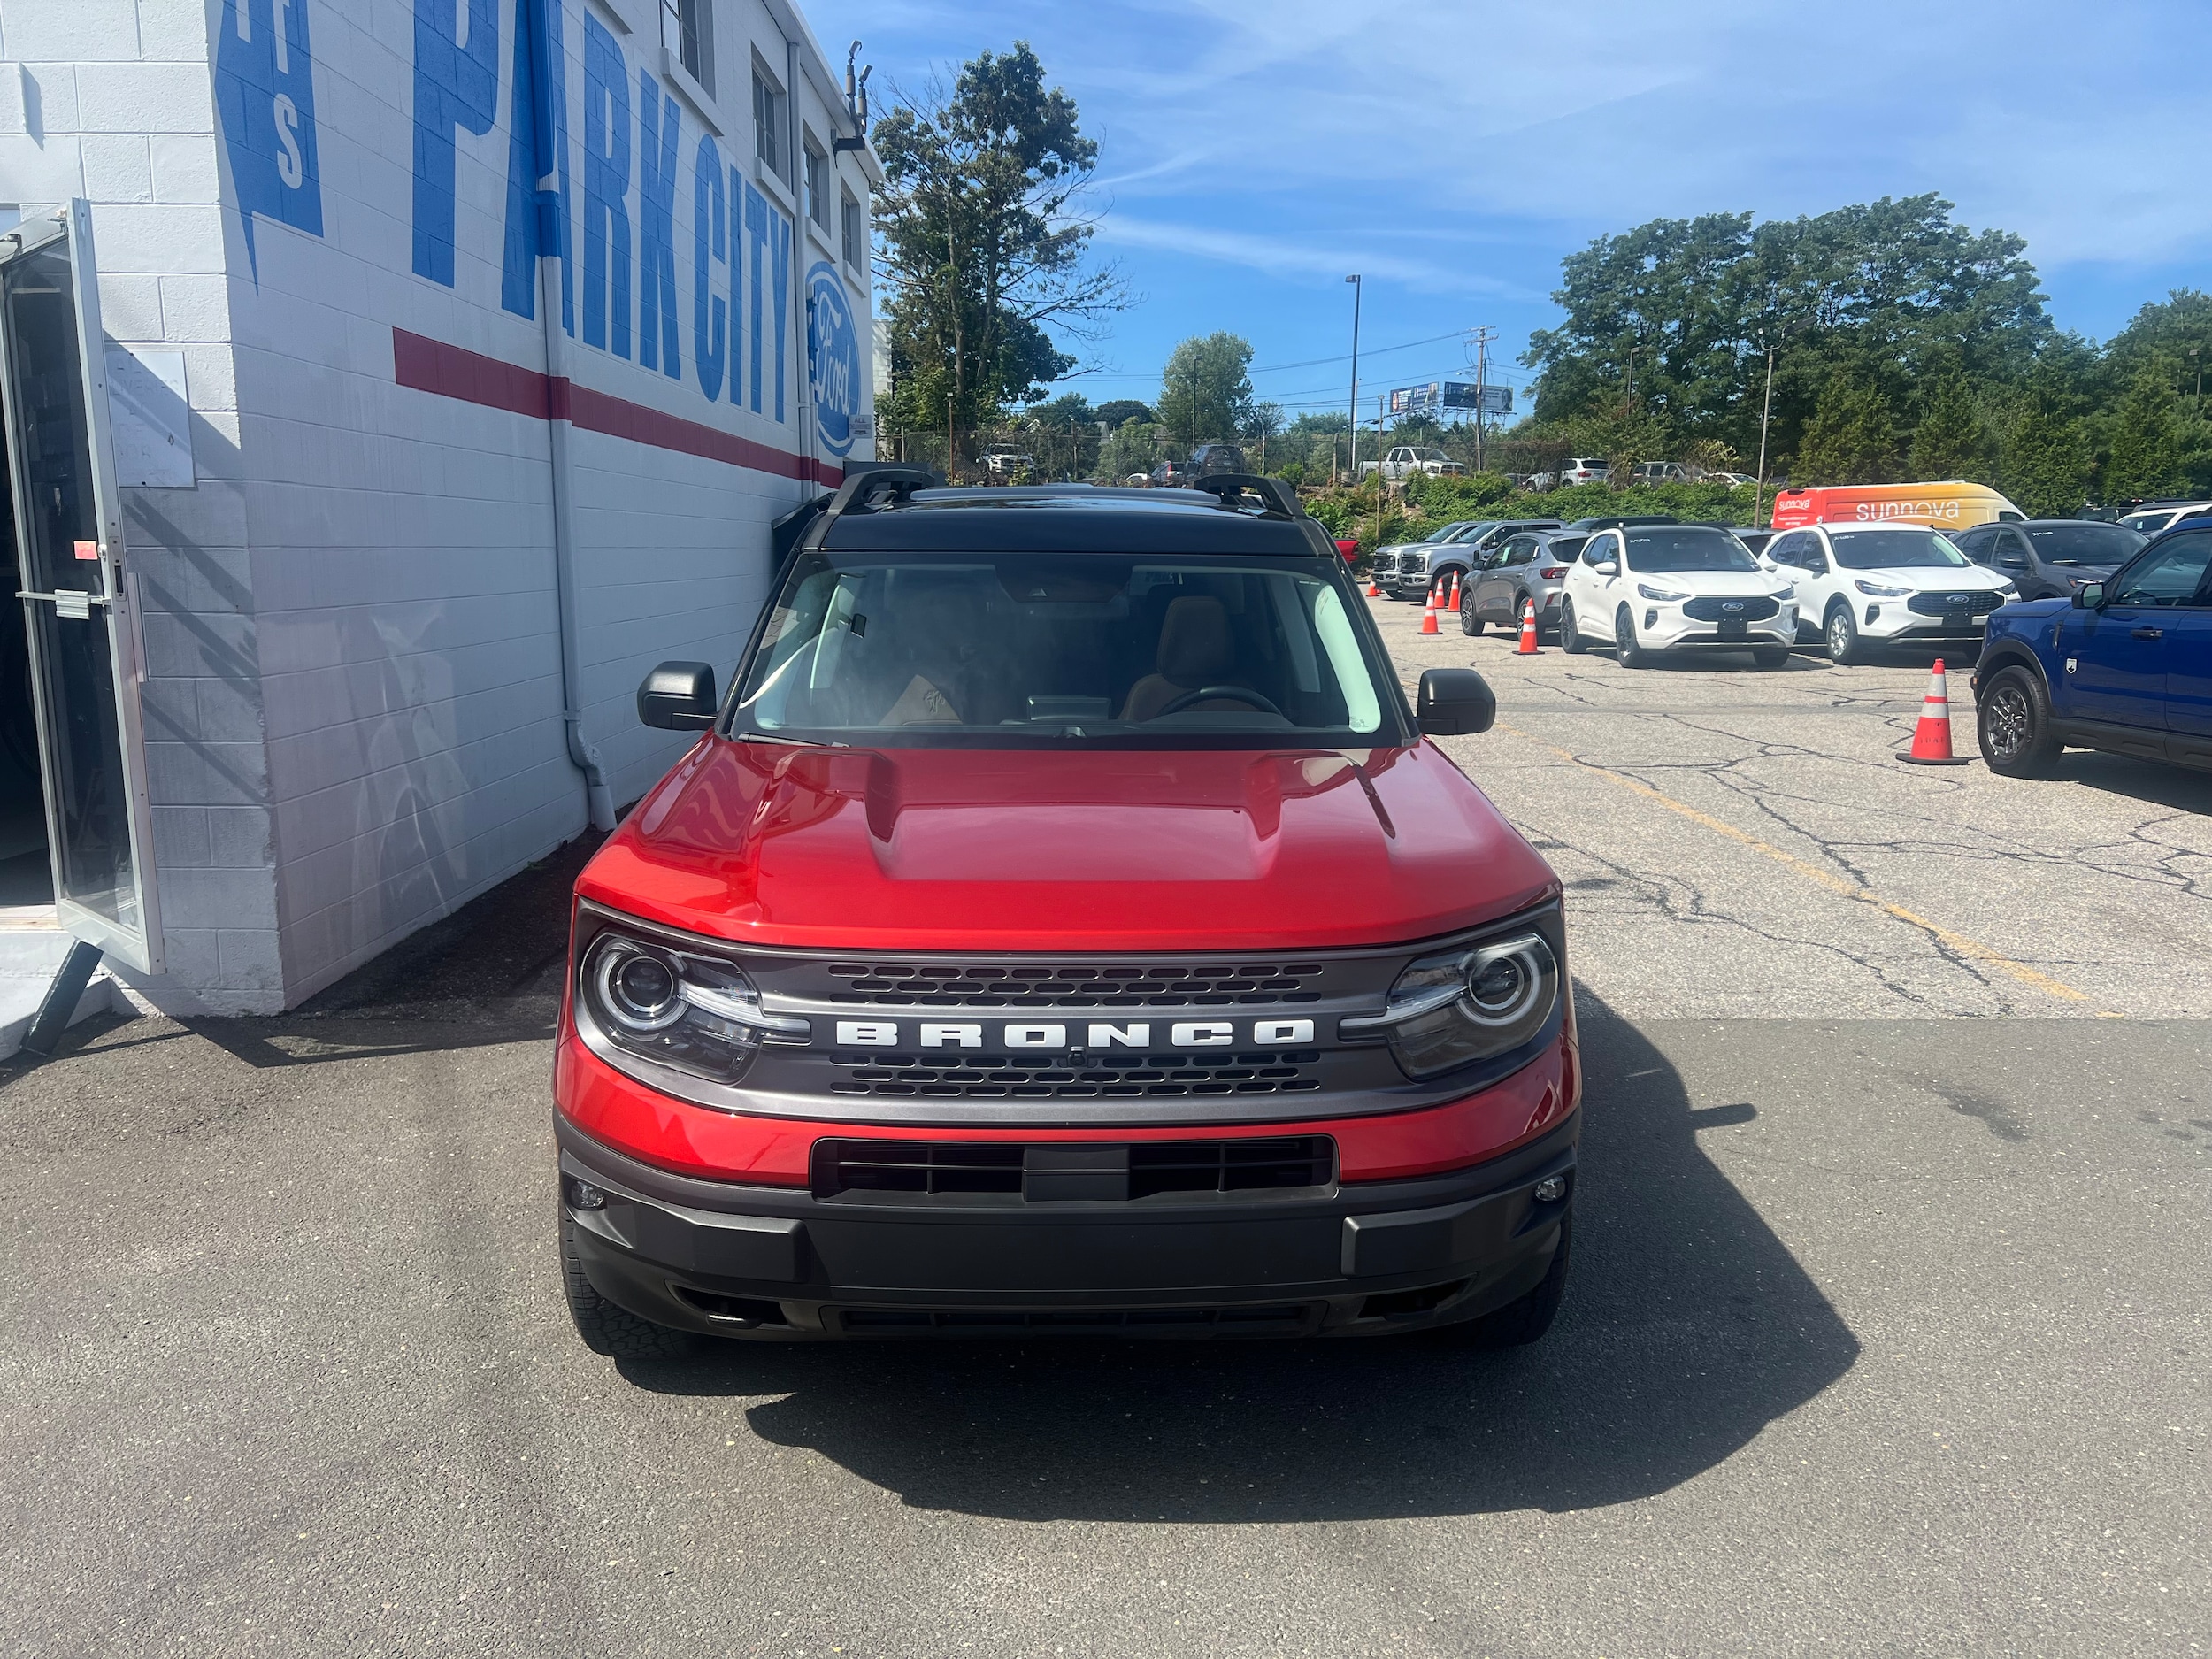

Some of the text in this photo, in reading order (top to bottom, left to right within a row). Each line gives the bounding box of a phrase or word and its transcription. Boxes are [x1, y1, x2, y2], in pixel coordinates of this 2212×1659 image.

[411, 0, 790, 424] PARK CITY
[814, 291, 850, 416] Ford
[1778, 498, 1810, 511] sunnova
[1856, 500, 1960, 521] sunnova
[836, 1019, 1315, 1048] BRONCO
